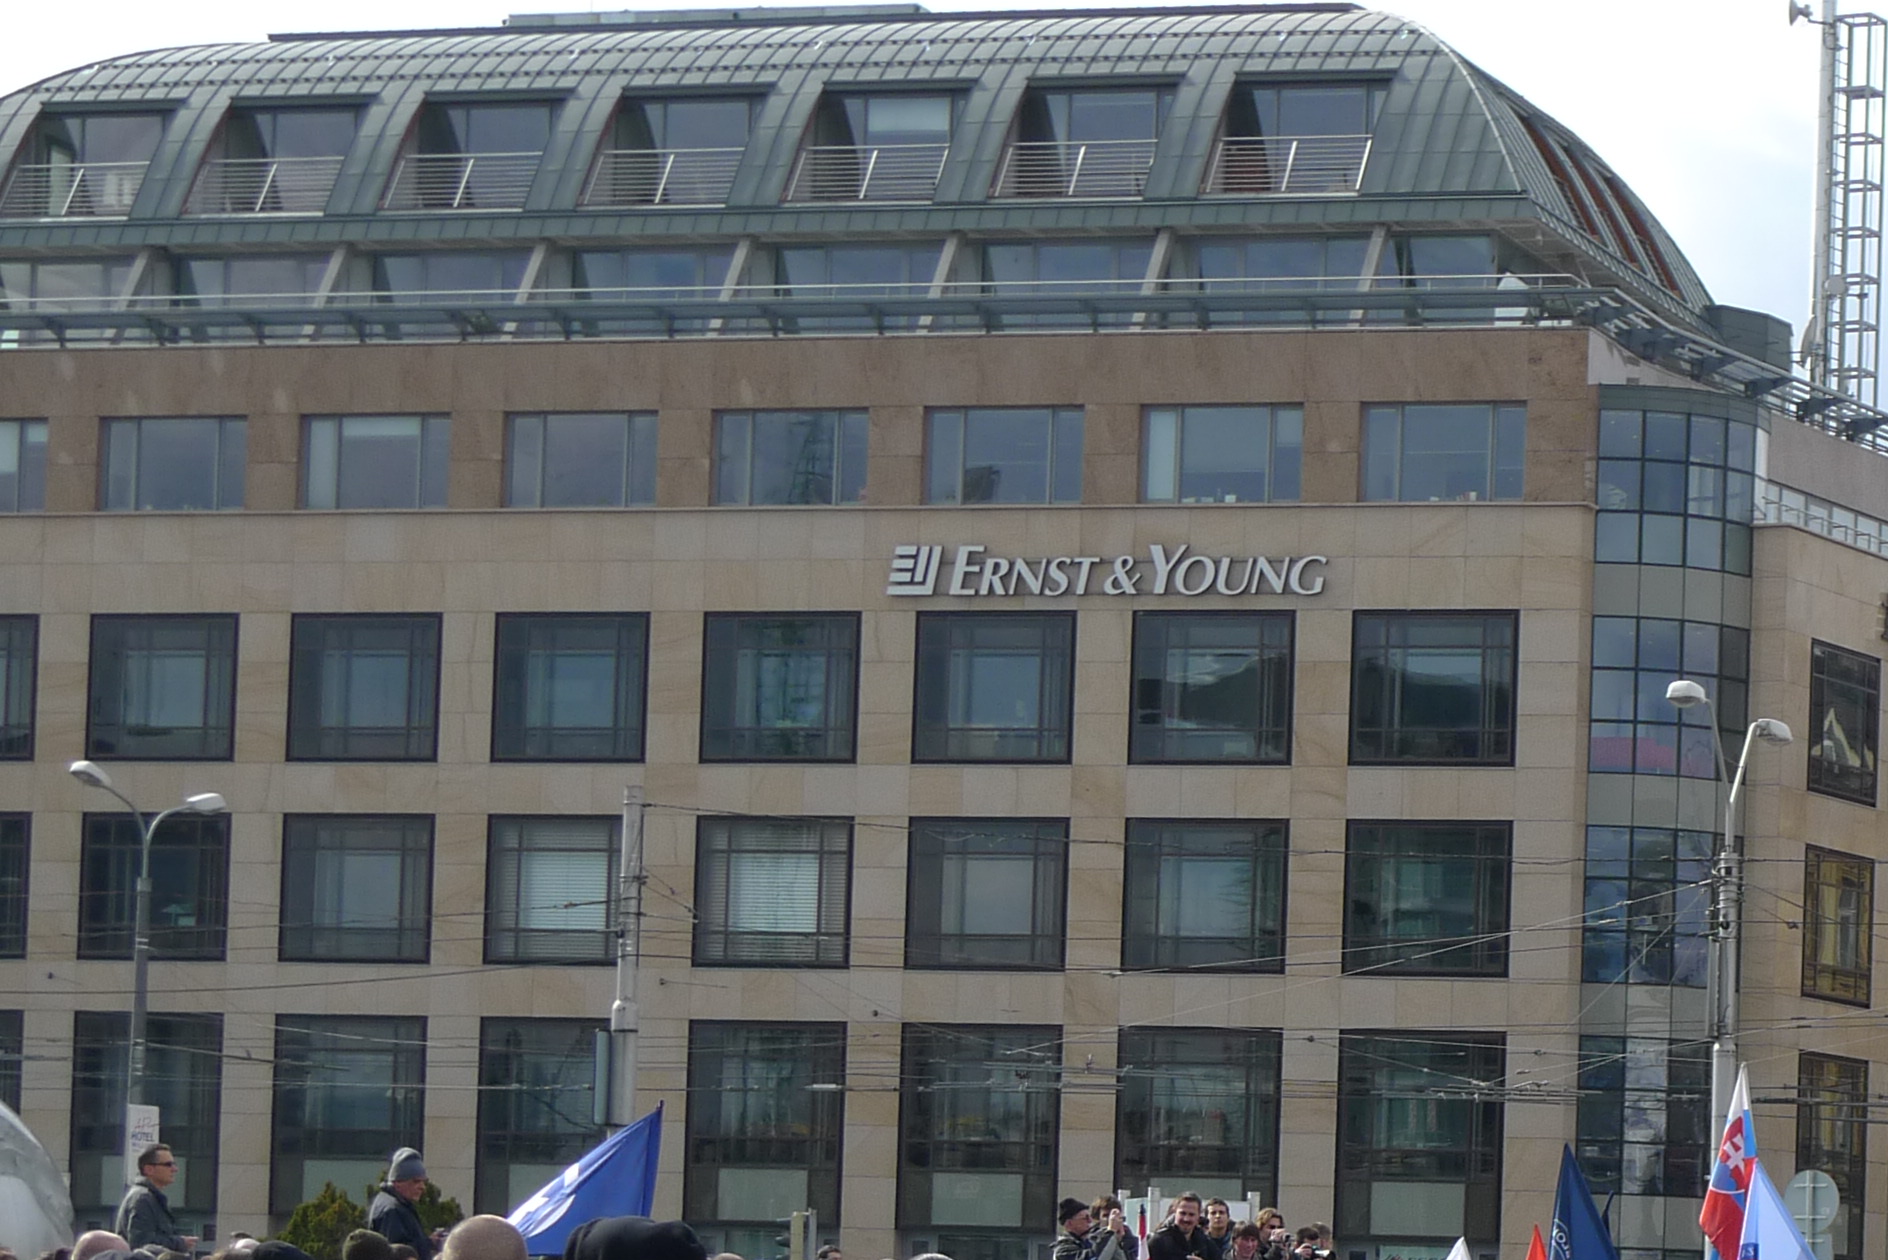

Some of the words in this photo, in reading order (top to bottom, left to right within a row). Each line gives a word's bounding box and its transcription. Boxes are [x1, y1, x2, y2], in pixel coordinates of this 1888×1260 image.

[949, 545, 1100, 596] ERNST
[1104, 555, 1143, 596] &
[1148, 544, 1329, 596] YOUNG
